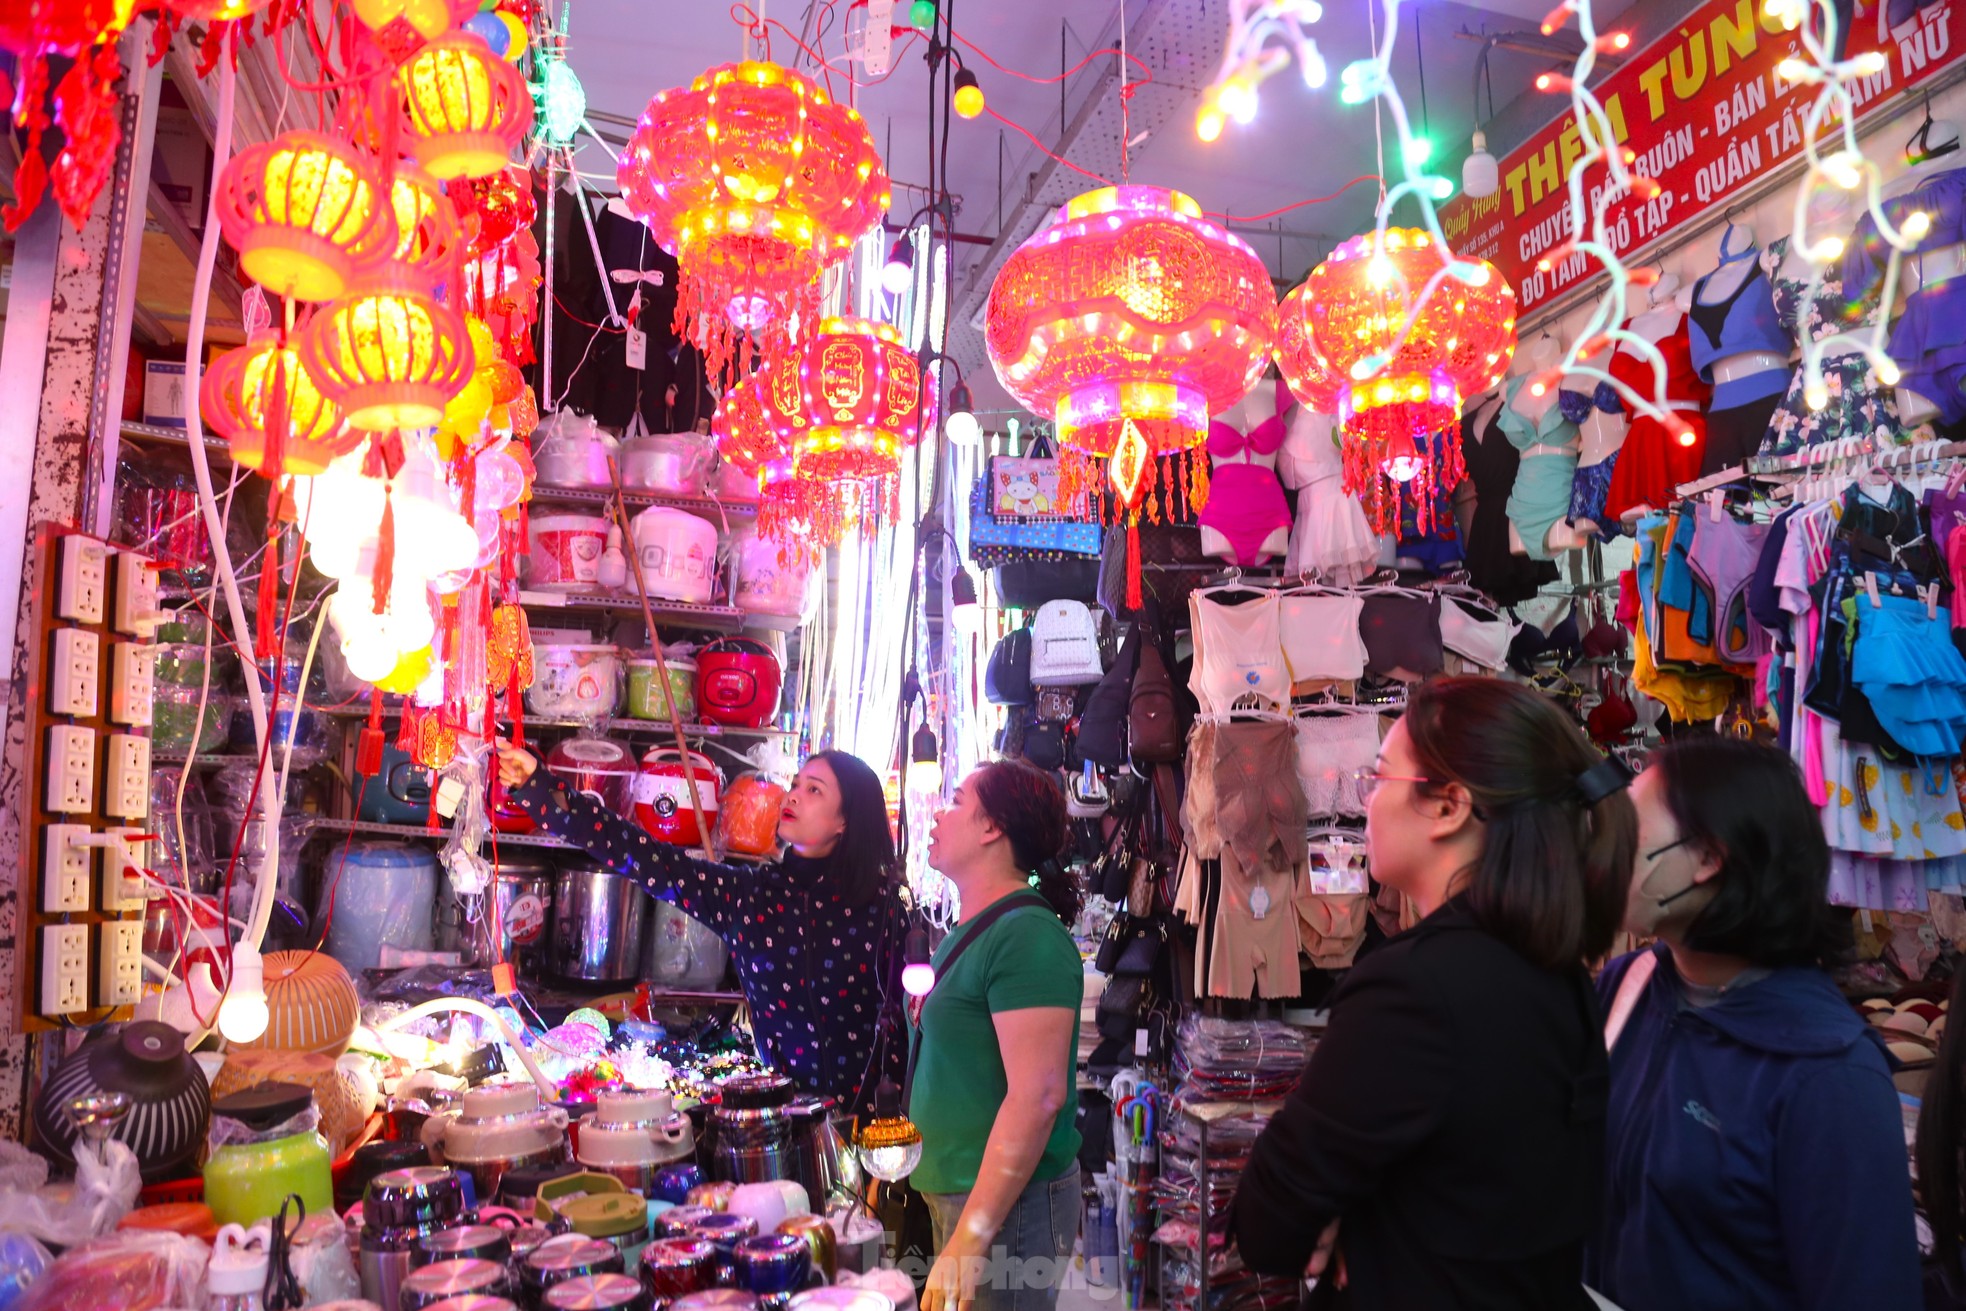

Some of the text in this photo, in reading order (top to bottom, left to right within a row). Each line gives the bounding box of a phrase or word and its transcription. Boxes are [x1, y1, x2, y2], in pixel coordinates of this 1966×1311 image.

[1505, 92, 1628, 218] THÊM
[1634, 190, 1673, 239] TẬP
[1695, 135, 1761, 204] QUẦN
[1765, 97, 1812, 160] TẤT
[1899, 7, 1951, 78] NỮ
[1634, 123, 1694, 182] BUÔN
[1714, 74, 1767, 137] BÁN
